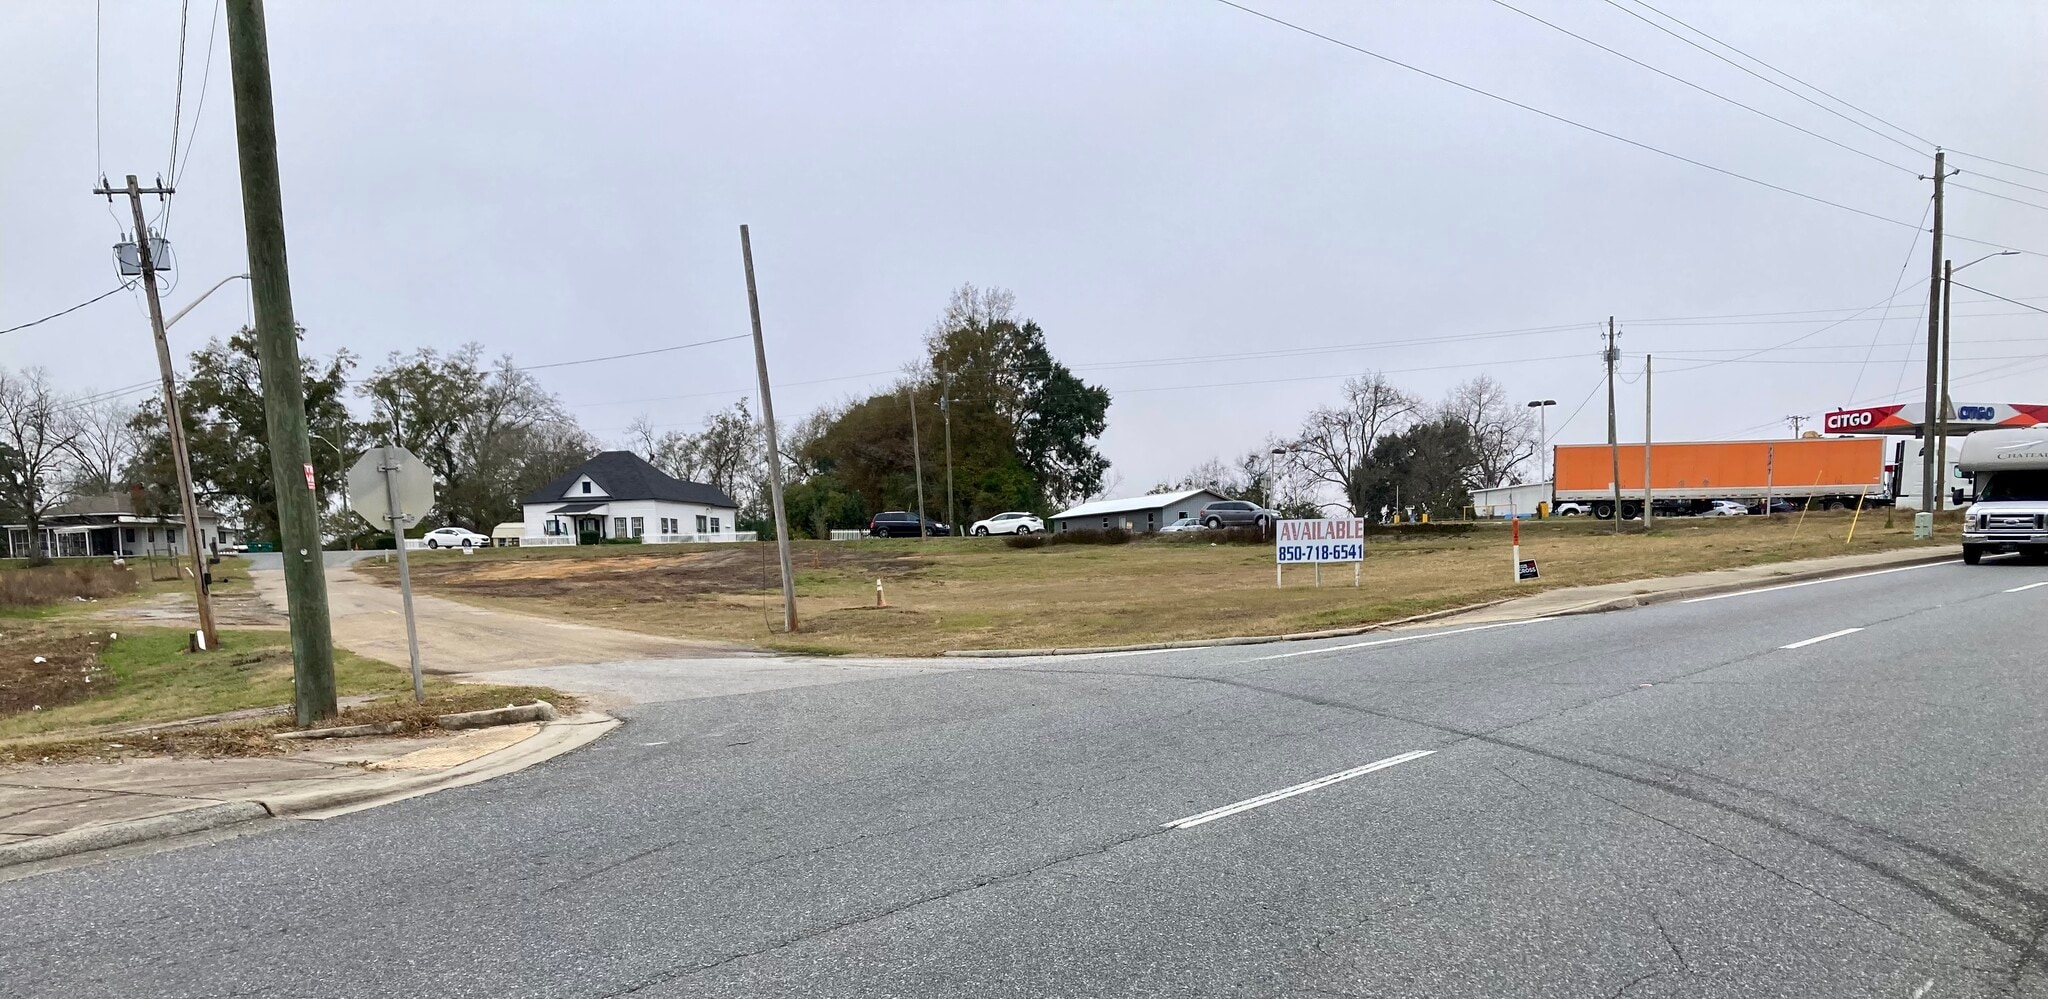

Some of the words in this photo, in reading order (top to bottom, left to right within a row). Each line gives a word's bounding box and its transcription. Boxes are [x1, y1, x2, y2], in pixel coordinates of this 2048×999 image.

[1828, 411, 1872, 429] CITGO
[1281, 520, 1363, 541] AVAILABLE
[1279, 544, 1362, 561] 850-718-6541
